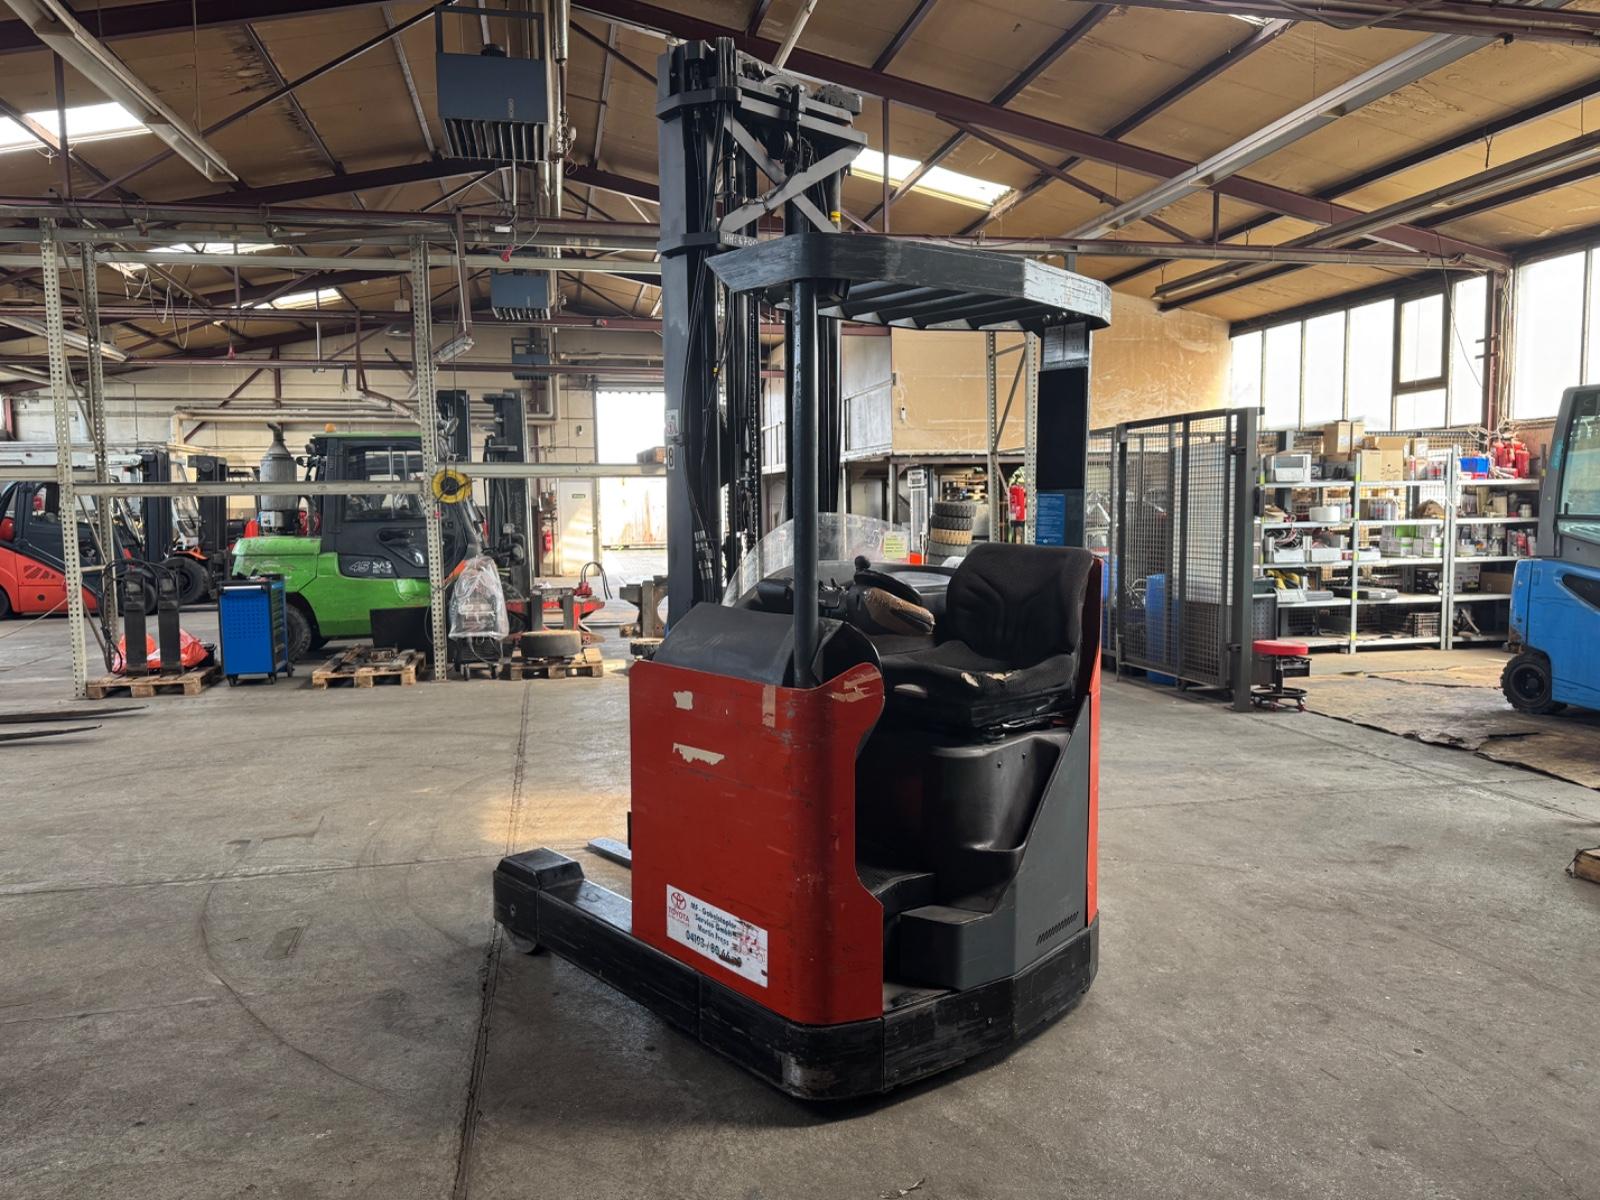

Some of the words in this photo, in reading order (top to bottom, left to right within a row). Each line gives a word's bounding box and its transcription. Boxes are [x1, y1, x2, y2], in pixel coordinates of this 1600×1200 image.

[668, 906, 689, 921] TOYOTA
[695, 913, 715, 929] Service
[698, 924, 715, 939] Martin
